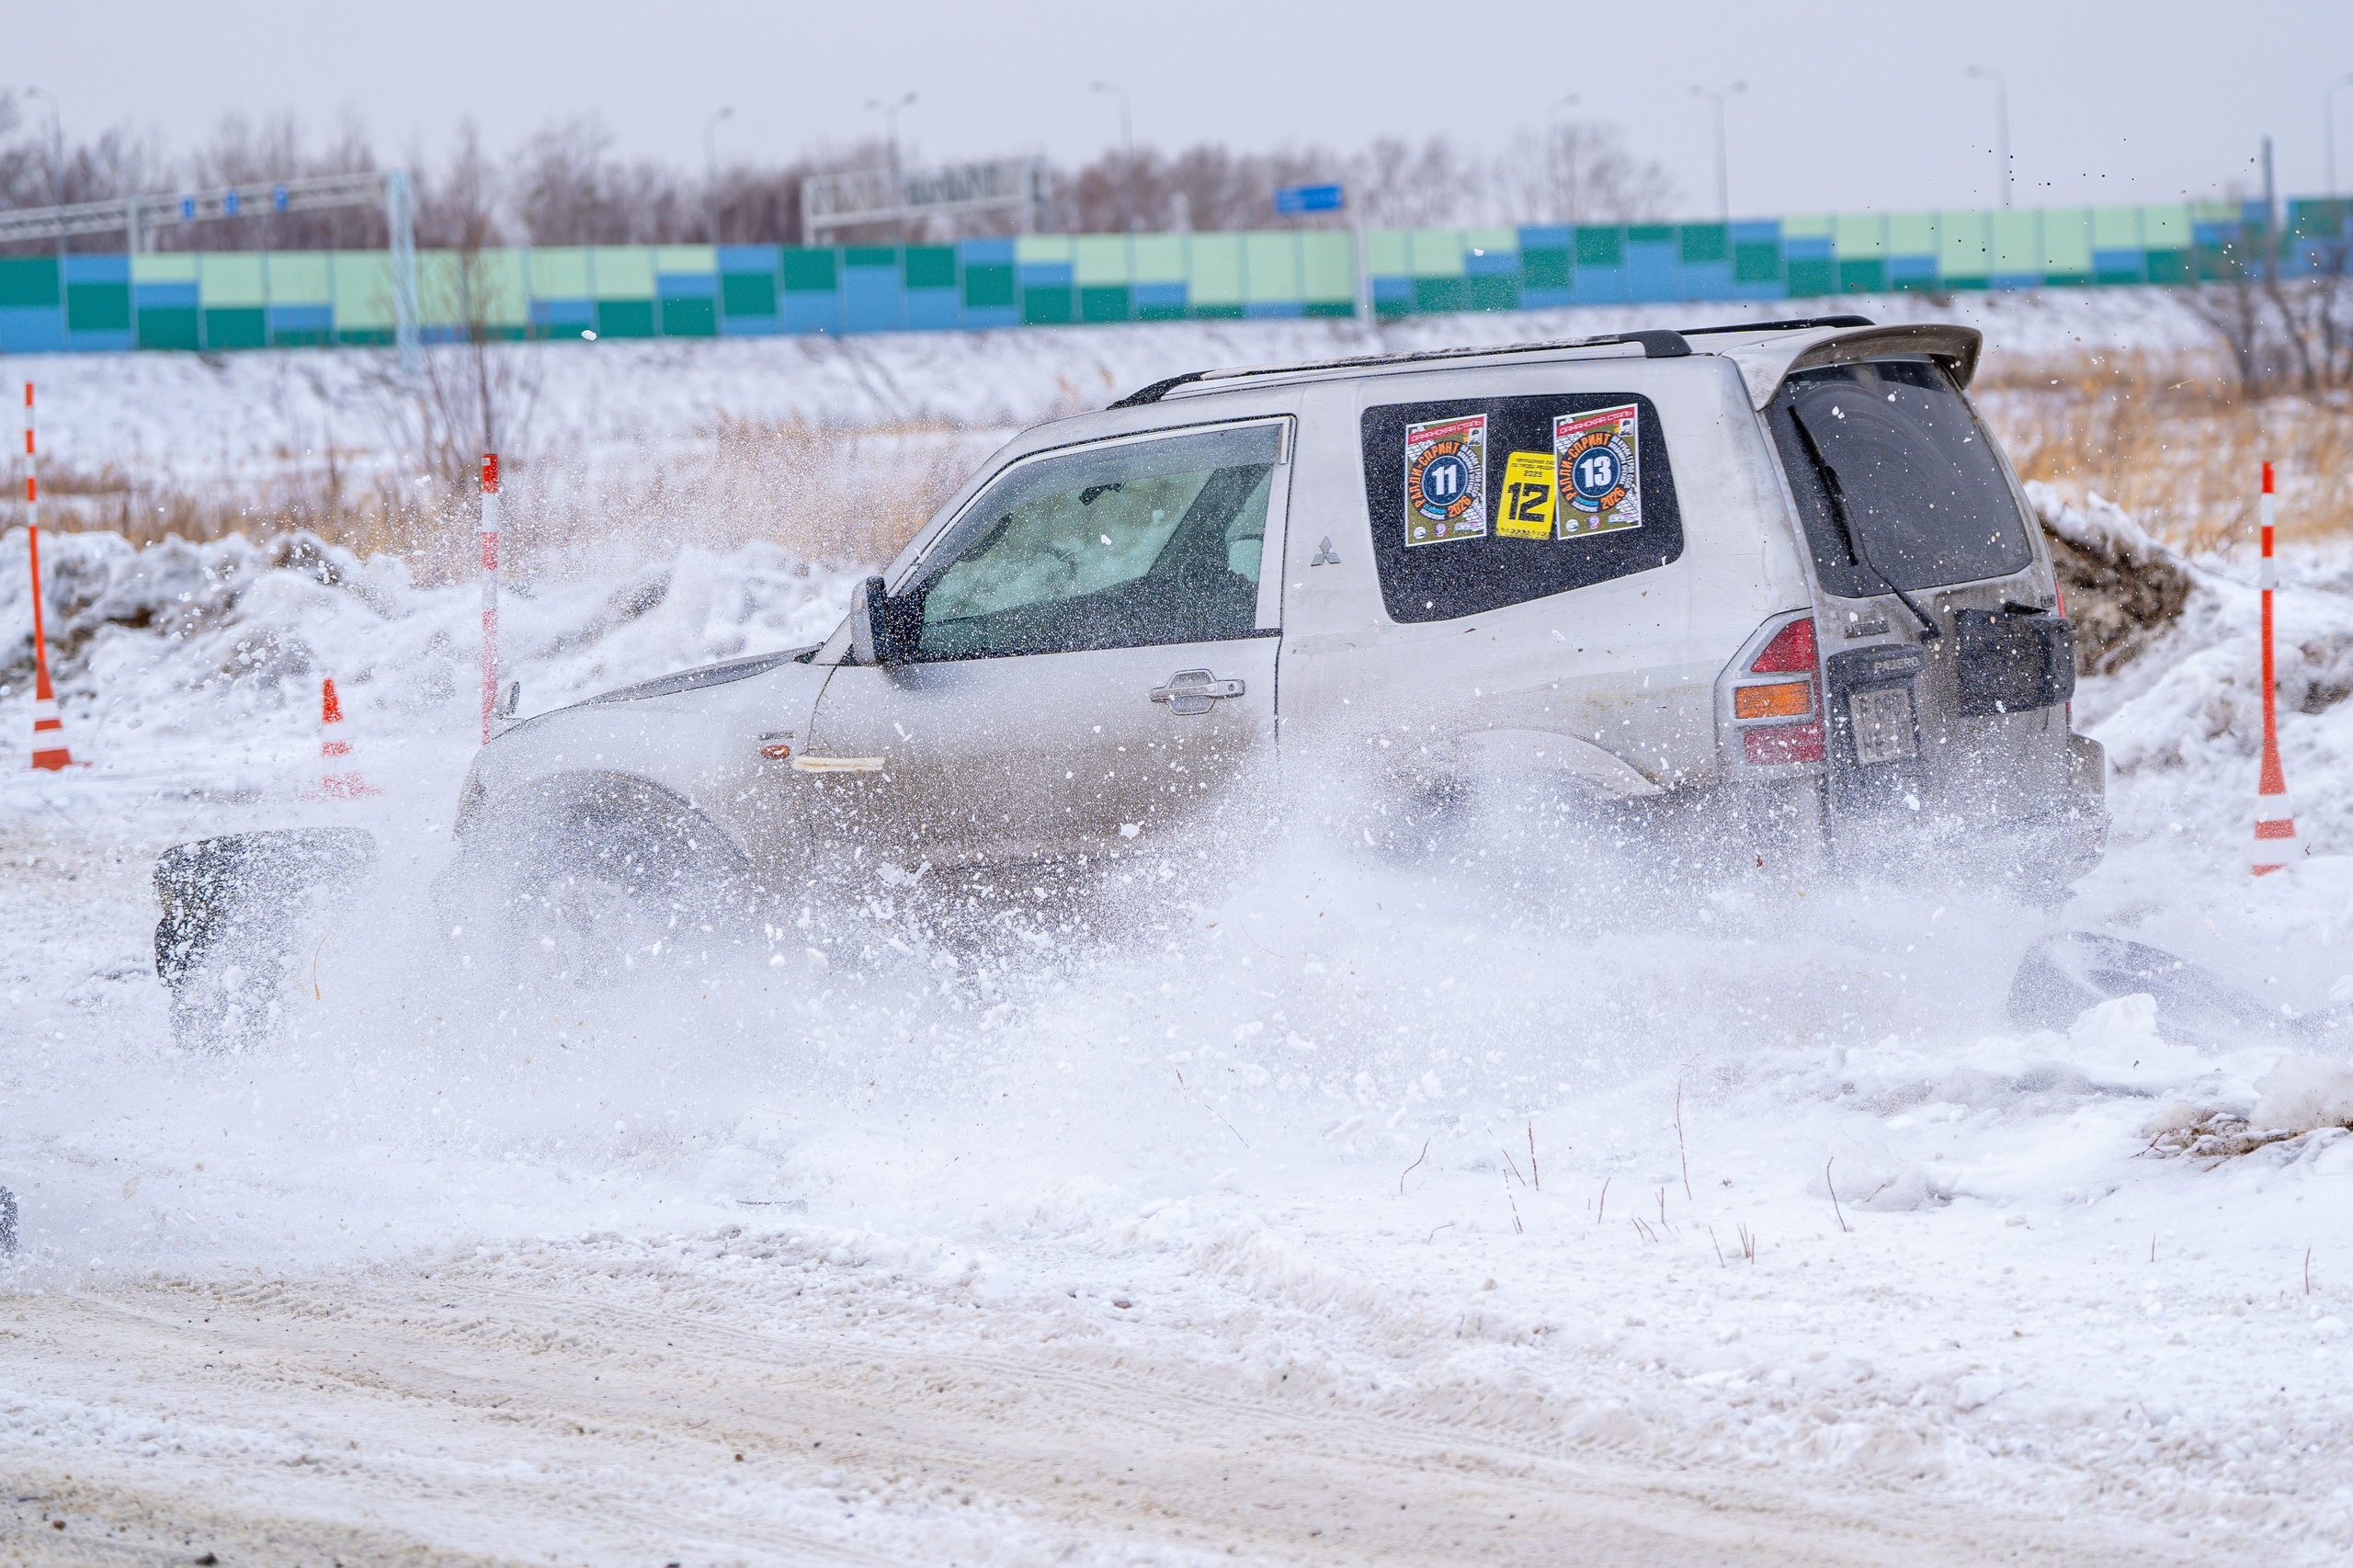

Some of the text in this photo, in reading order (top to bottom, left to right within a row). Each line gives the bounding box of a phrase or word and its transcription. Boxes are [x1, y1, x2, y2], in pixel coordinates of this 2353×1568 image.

[1432, 464, 1457, 495] 11
[1523, 470, 1543, 478] 2025
[1580, 456, 1612, 488] 13
[1448, 495, 1472, 518] 2026
[1507, 482, 1551, 523] 12
[1600, 486, 1626, 510] 2026
[1873, 656, 1919, 672] PAJERO
